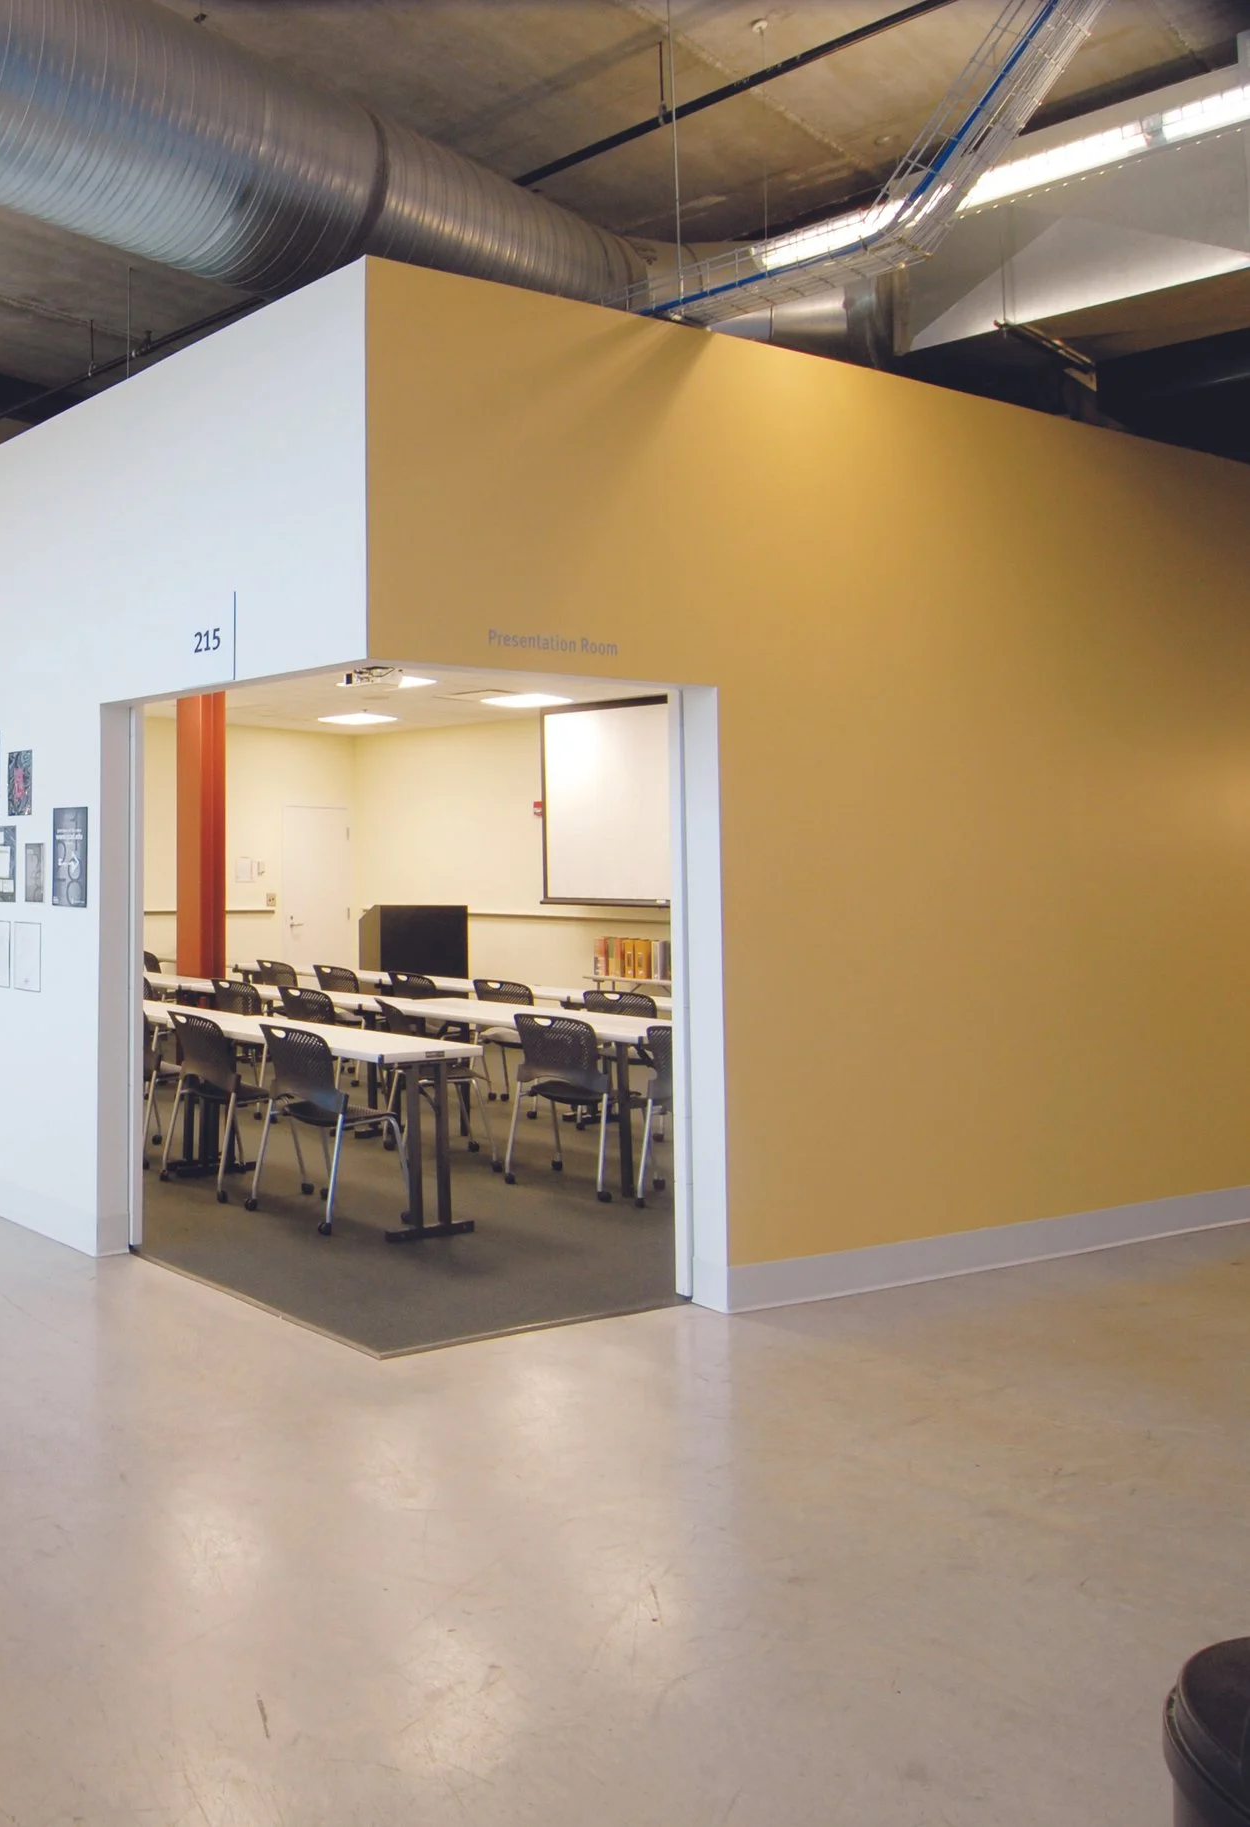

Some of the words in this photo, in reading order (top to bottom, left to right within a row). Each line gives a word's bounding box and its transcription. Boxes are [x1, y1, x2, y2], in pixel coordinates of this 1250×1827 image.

[194, 627, 221, 653] 215
[488, 628, 576, 653] Presentation
[581, 637, 618, 656] Room
